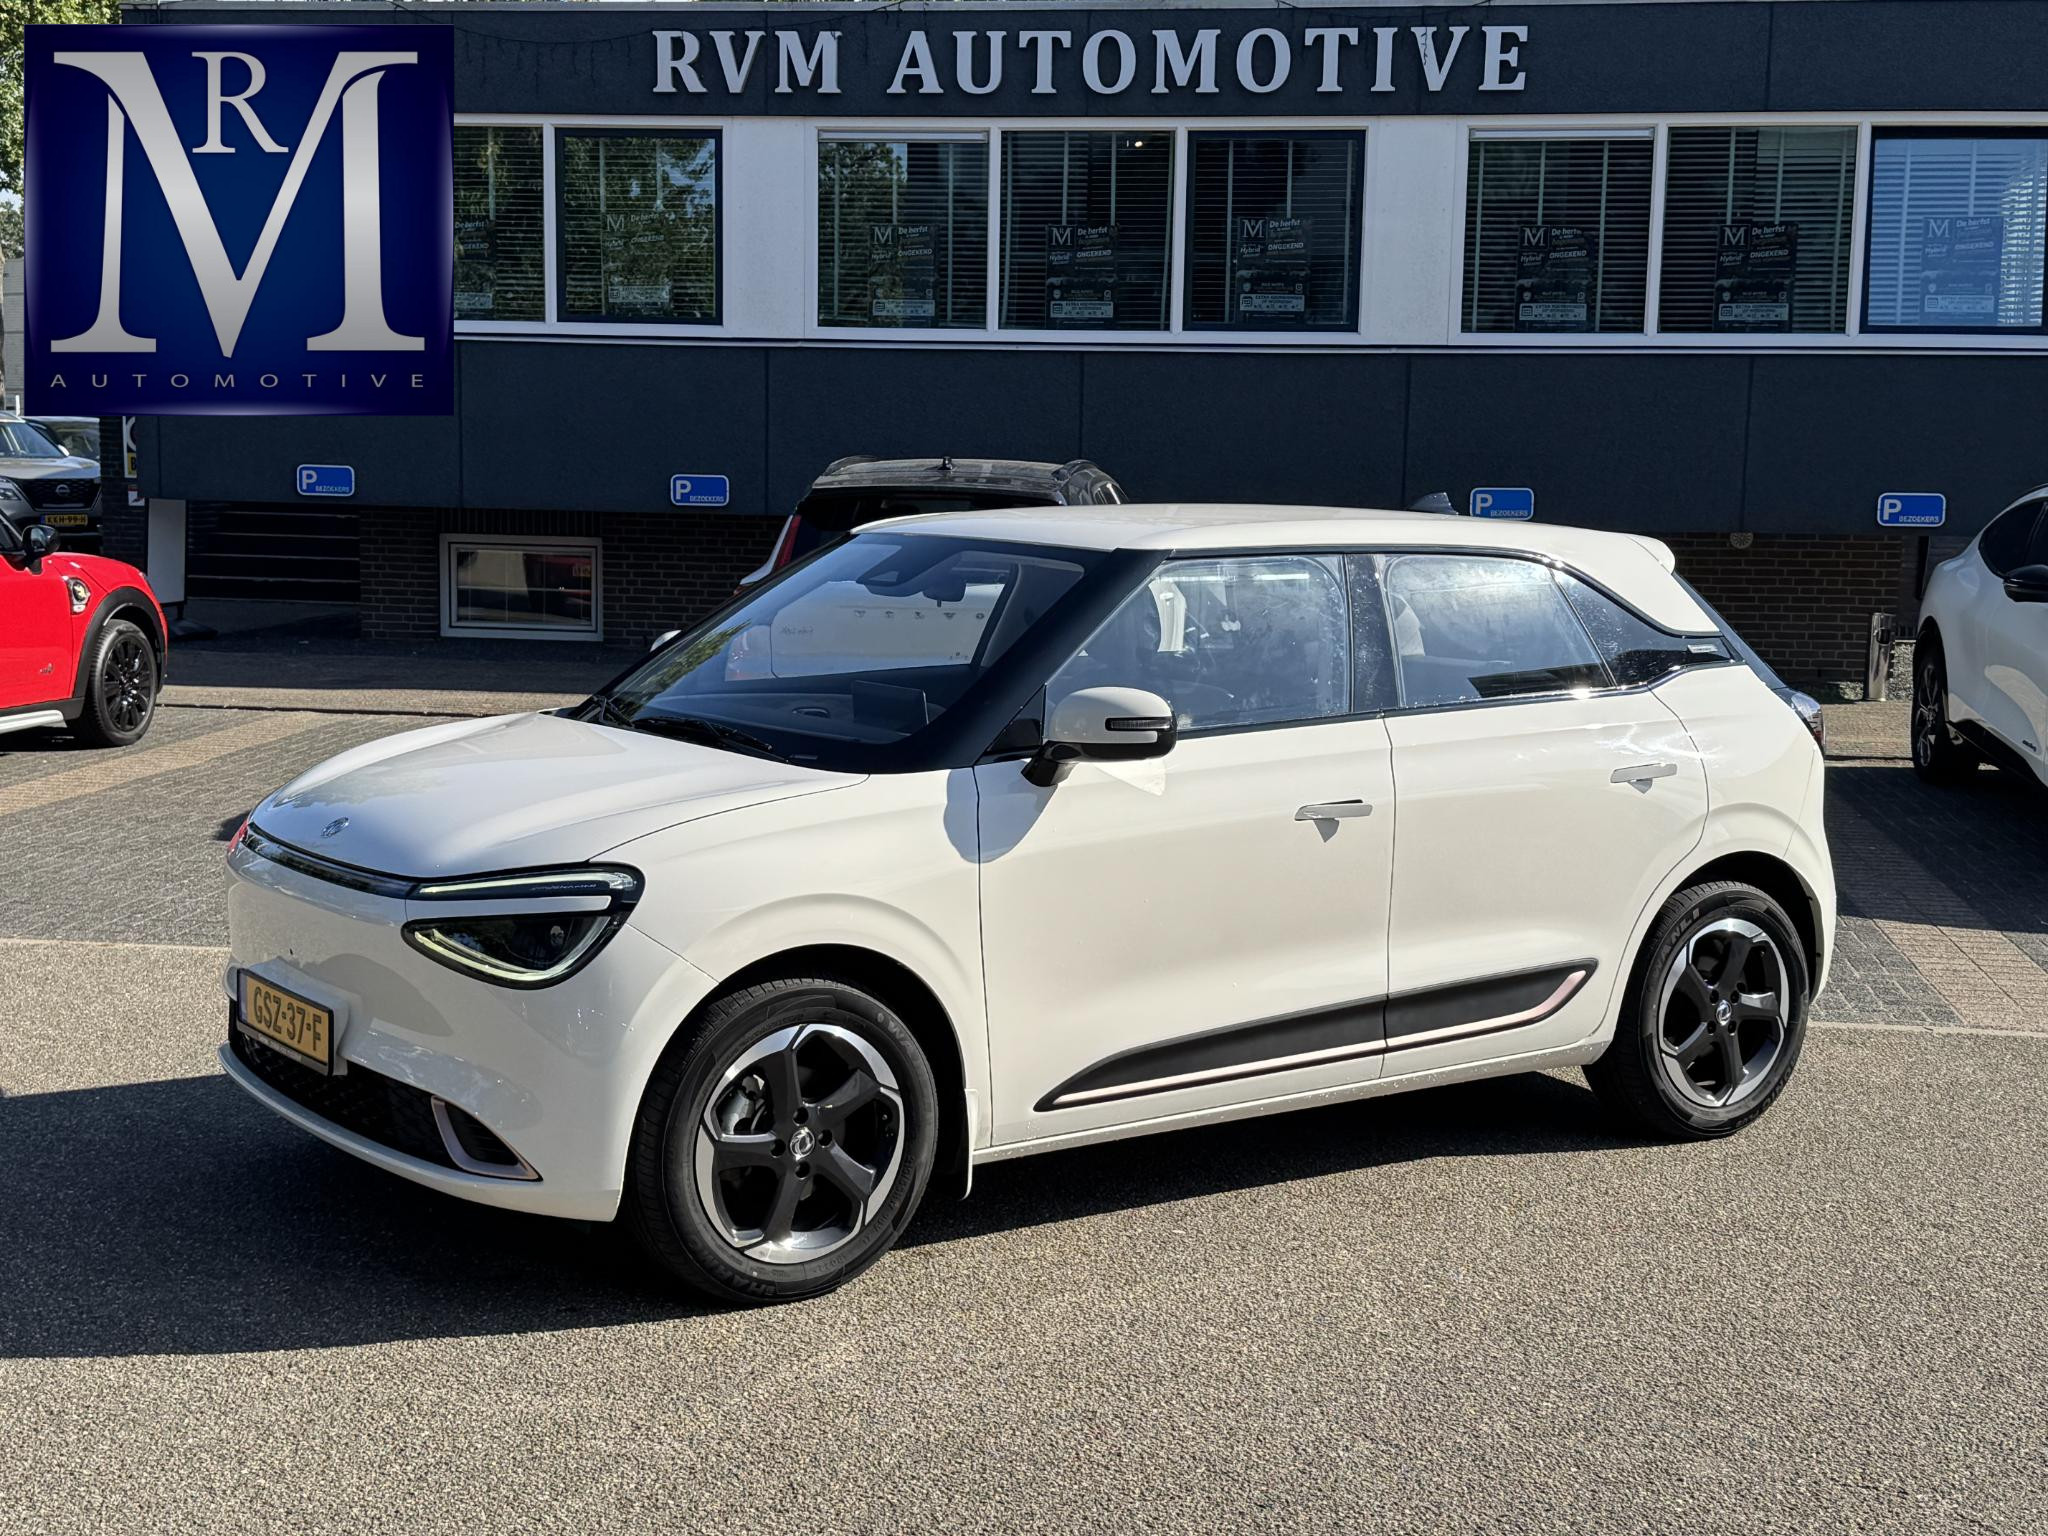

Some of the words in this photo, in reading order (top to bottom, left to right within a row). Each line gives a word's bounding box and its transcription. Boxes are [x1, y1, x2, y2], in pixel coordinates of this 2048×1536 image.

[652, 29, 843, 95] RVM
[886, 25, 1529, 95] AUTOMOTIVE
[1280, 219, 1301, 227] herfst
[898, 227, 907, 235] De
[1077, 228, 1087, 236] De
[1088, 226, 1108, 235] herfst
[1551, 228, 1561, 236] De
[1751, 227, 1762, 235] De
[1763, 225, 1785, 234] herfst
[1267, 242, 1304, 251] ONGEKEND
[1076, 249, 1112, 258] ONGEKEND
[1549, 250, 1587, 259] ONGEKEND
[1750, 249, 1789, 258] ONGEKEND
[302, 469, 318, 490] P
[676, 479, 692, 501] P
[1475, 493, 1493, 515] P
[1490, 509, 1529, 517] BEZOEKERS
[1882, 498, 1902, 521] P
[1898, 515, 1940, 523] BEZOEKERS
[254, 986, 322, 1052] GSZ-37-F
